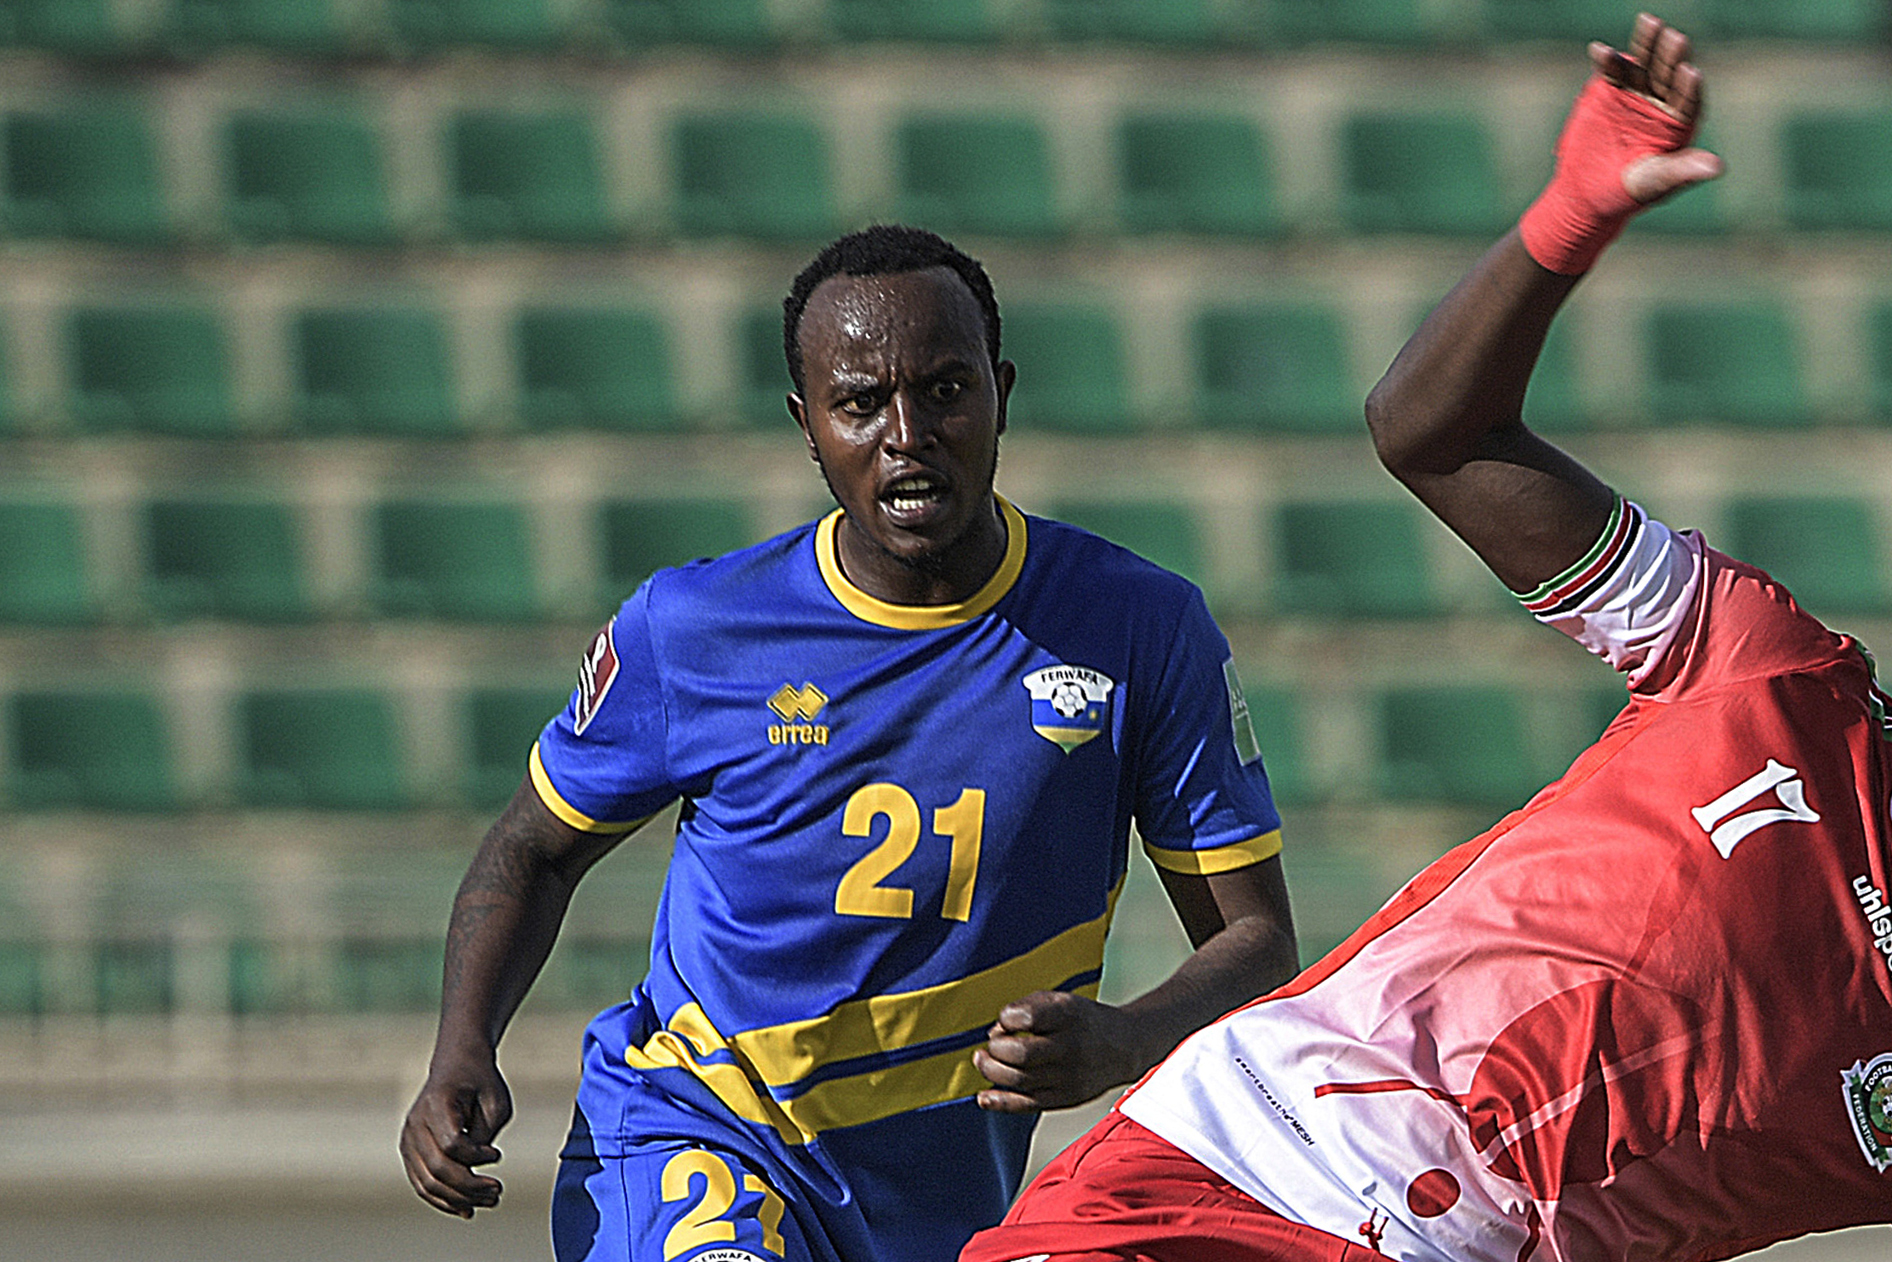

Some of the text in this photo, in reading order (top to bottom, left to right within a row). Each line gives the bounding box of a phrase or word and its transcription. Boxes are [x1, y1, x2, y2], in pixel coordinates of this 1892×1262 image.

[1041, 670, 1098, 685] FERWAFA
[767, 724, 830, 745] errea
[1691, 758, 1820, 860] 17
[835, 783, 985, 922] 21
[1290, 1120, 1316, 1146] MESH
[661, 1148, 785, 1262] 21
